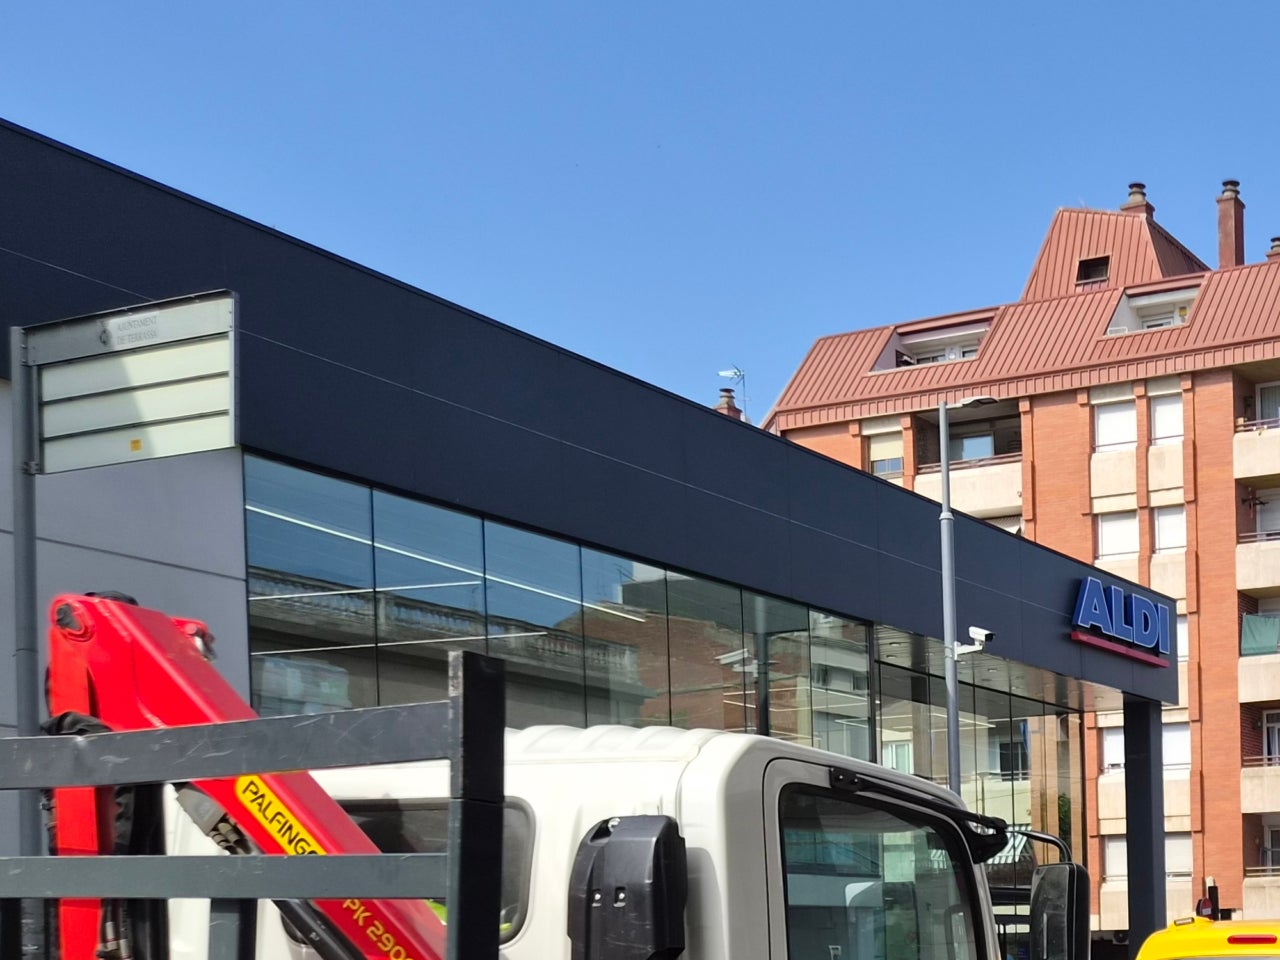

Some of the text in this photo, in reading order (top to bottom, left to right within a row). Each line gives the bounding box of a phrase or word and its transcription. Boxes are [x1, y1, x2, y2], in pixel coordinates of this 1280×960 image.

[1074, 576, 1170, 654] ALDI
[241, 779, 320, 856] PALFING
[342, 899, 372, 926] PK
